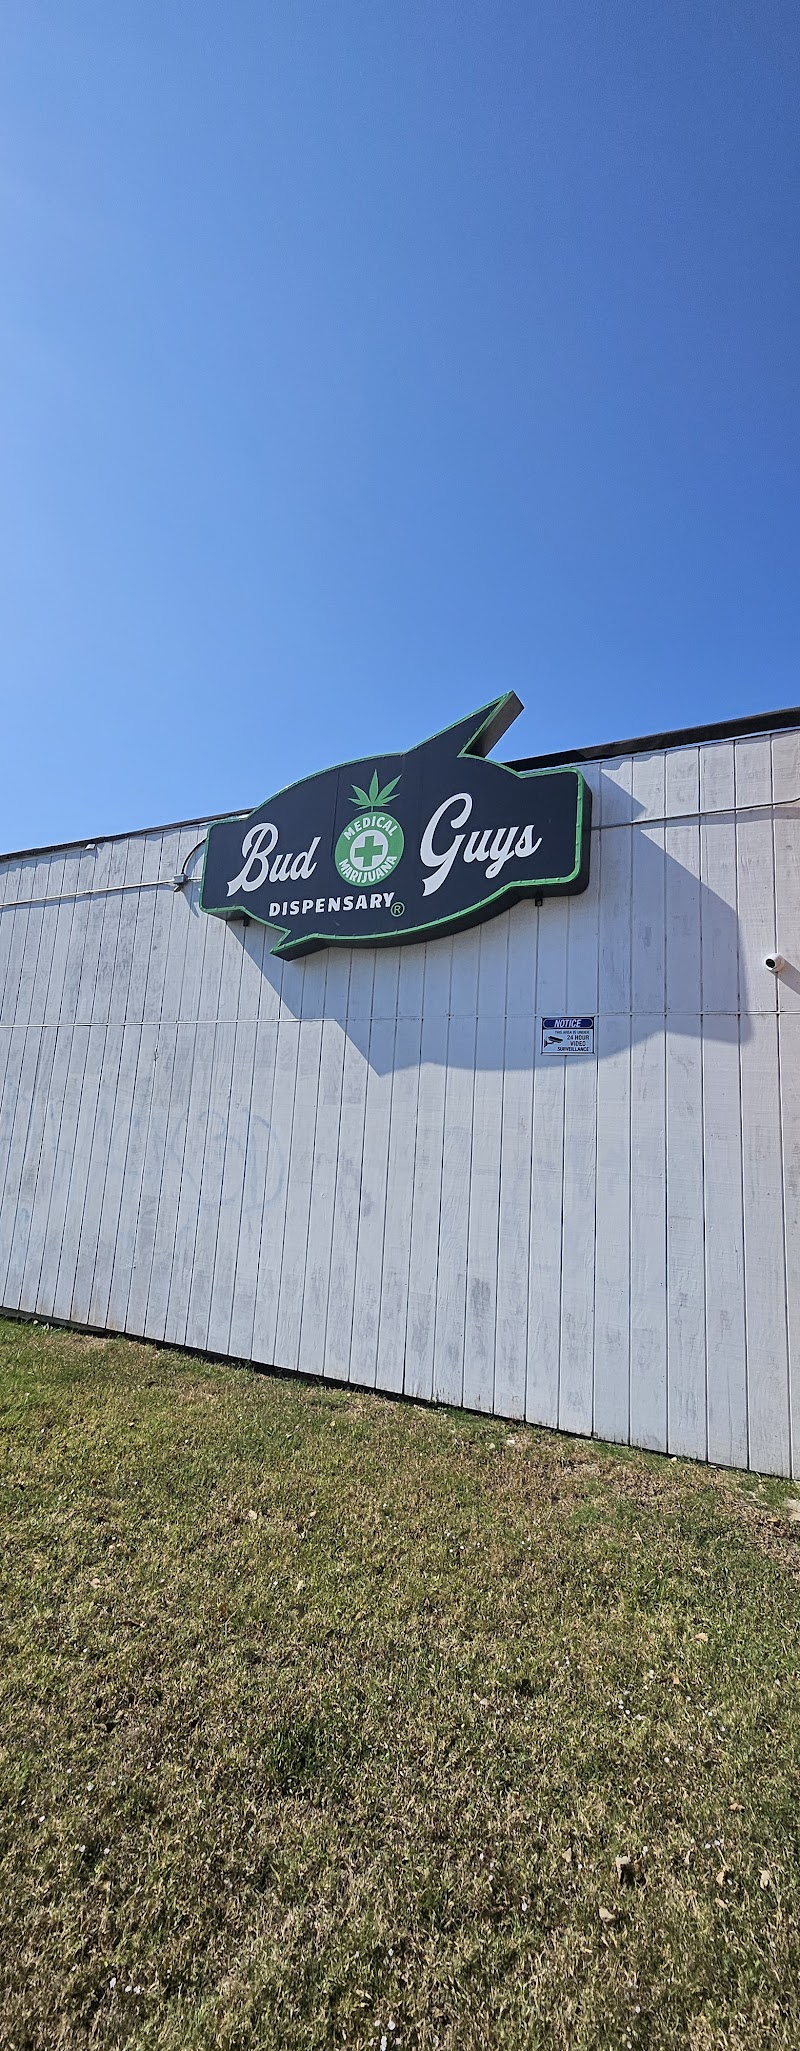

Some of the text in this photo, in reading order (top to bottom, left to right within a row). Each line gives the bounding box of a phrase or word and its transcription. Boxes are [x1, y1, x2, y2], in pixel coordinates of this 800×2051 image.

[343, 815, 398, 841] MEDICAL
[226, 792, 543, 897] Bud Guys
[338, 855, 398, 884] MARIJUANA
[268, 891, 395, 917] DISPENSARY
[554, 1019, 582, 1028] NOTICE
